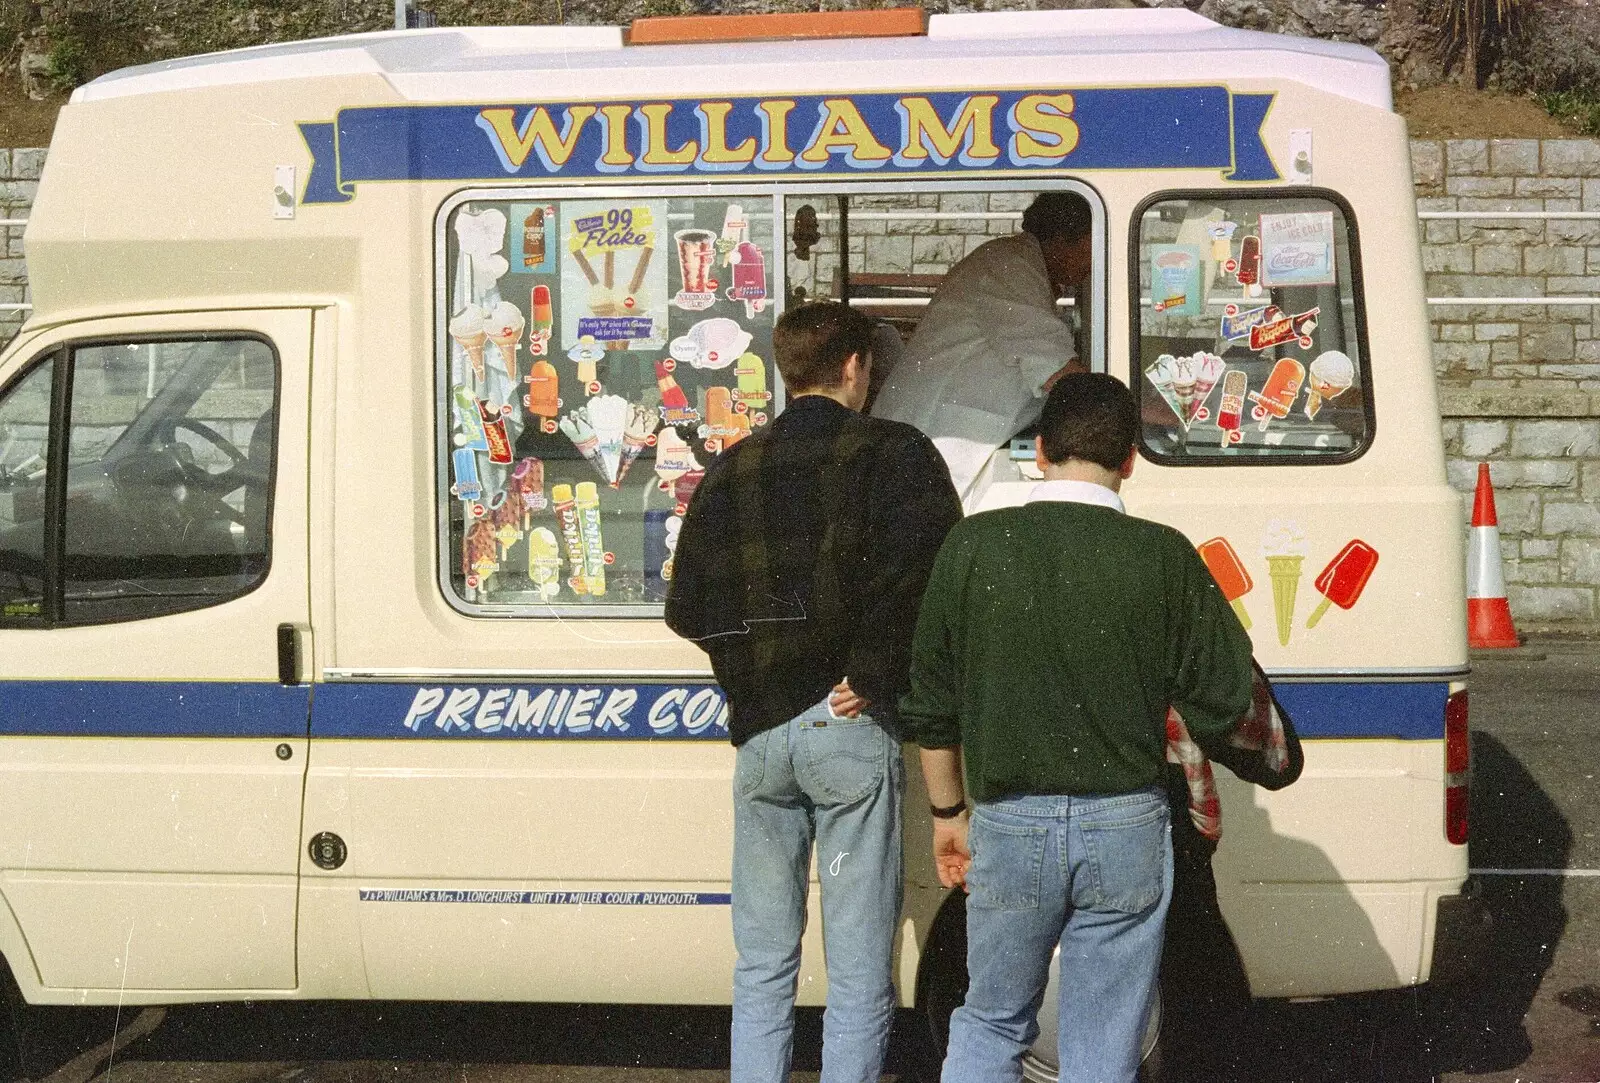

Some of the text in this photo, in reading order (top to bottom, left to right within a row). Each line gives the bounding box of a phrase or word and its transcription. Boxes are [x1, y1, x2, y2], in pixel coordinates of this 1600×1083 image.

[475, 93, 1081, 174] WILLIAMS
[607, 208, 633, 231] 99
[1271, 218, 1297, 232] ENJOY
[582, 226, 647, 248] Flake
[1288, 222, 1323, 241] ICE COLD
[1222, 396, 1242, 404] SUPER
[1222, 403, 1238, 414] STAR
[403, 687, 638, 733] PREMIER
[529, 893, 556, 905] UNIT
[569, 893, 601, 905] MILLER
